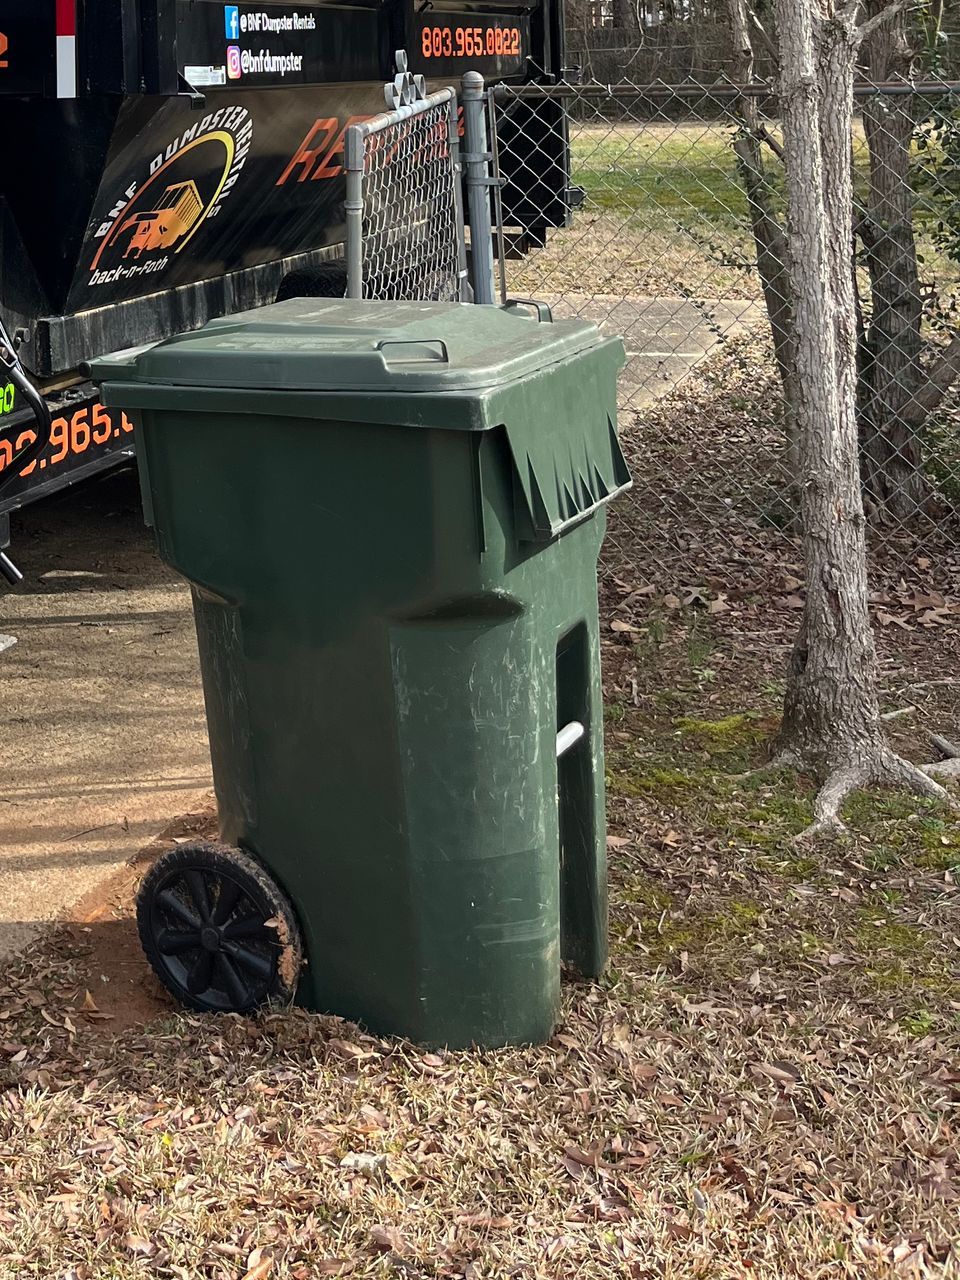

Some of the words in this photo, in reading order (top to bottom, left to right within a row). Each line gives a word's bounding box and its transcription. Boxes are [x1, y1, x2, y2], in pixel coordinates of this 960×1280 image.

[248, 12, 261, 31] BNF
[262, 12, 293, 34] Dumpster
[294, 12, 316, 30] Rentals
[422, 27, 519, 58] 803.965.0022
[241, 49, 302, 76] @bnfdumpster
[94, 181, 138, 238] BNF
[150, 106, 249, 175] DUMPSTER
[207, 119, 253, 218] RENTALS
[88, 256, 169, 286] back-n-Foth
